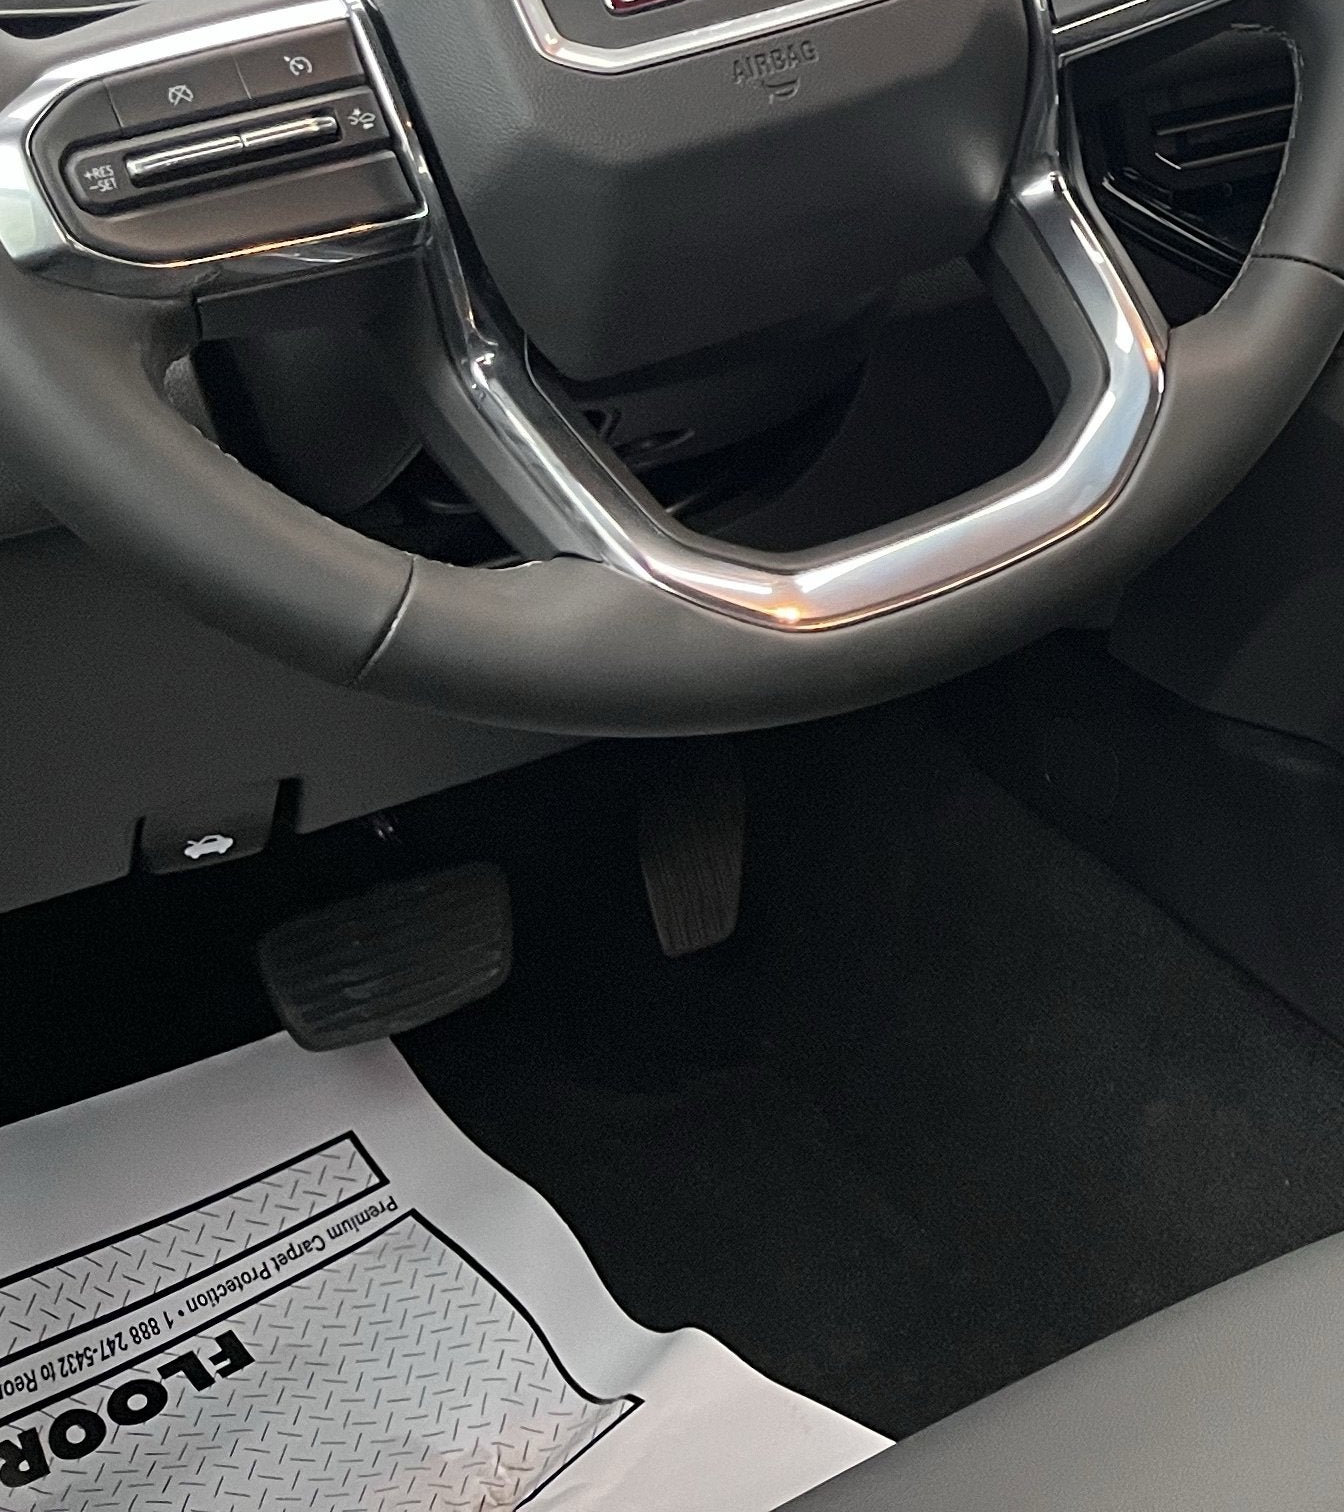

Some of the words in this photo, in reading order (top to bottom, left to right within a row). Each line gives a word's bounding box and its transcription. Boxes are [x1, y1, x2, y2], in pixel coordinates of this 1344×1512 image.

[731, 39, 820, 85] AIRBAG
[326, 1194, 398, 1241] Premium
[273, 1233, 327, 1272] Carpet
[185, 1262, 272, 1314] Protection
[129, 1317, 162, 1345] 888
[165, 1310, 175, 1330] 1
[41, 1361, 57, 1383] to
[60, 1330, 129, 1379] 247-5432
[0, 1329, 256, 1488] FLOOR
